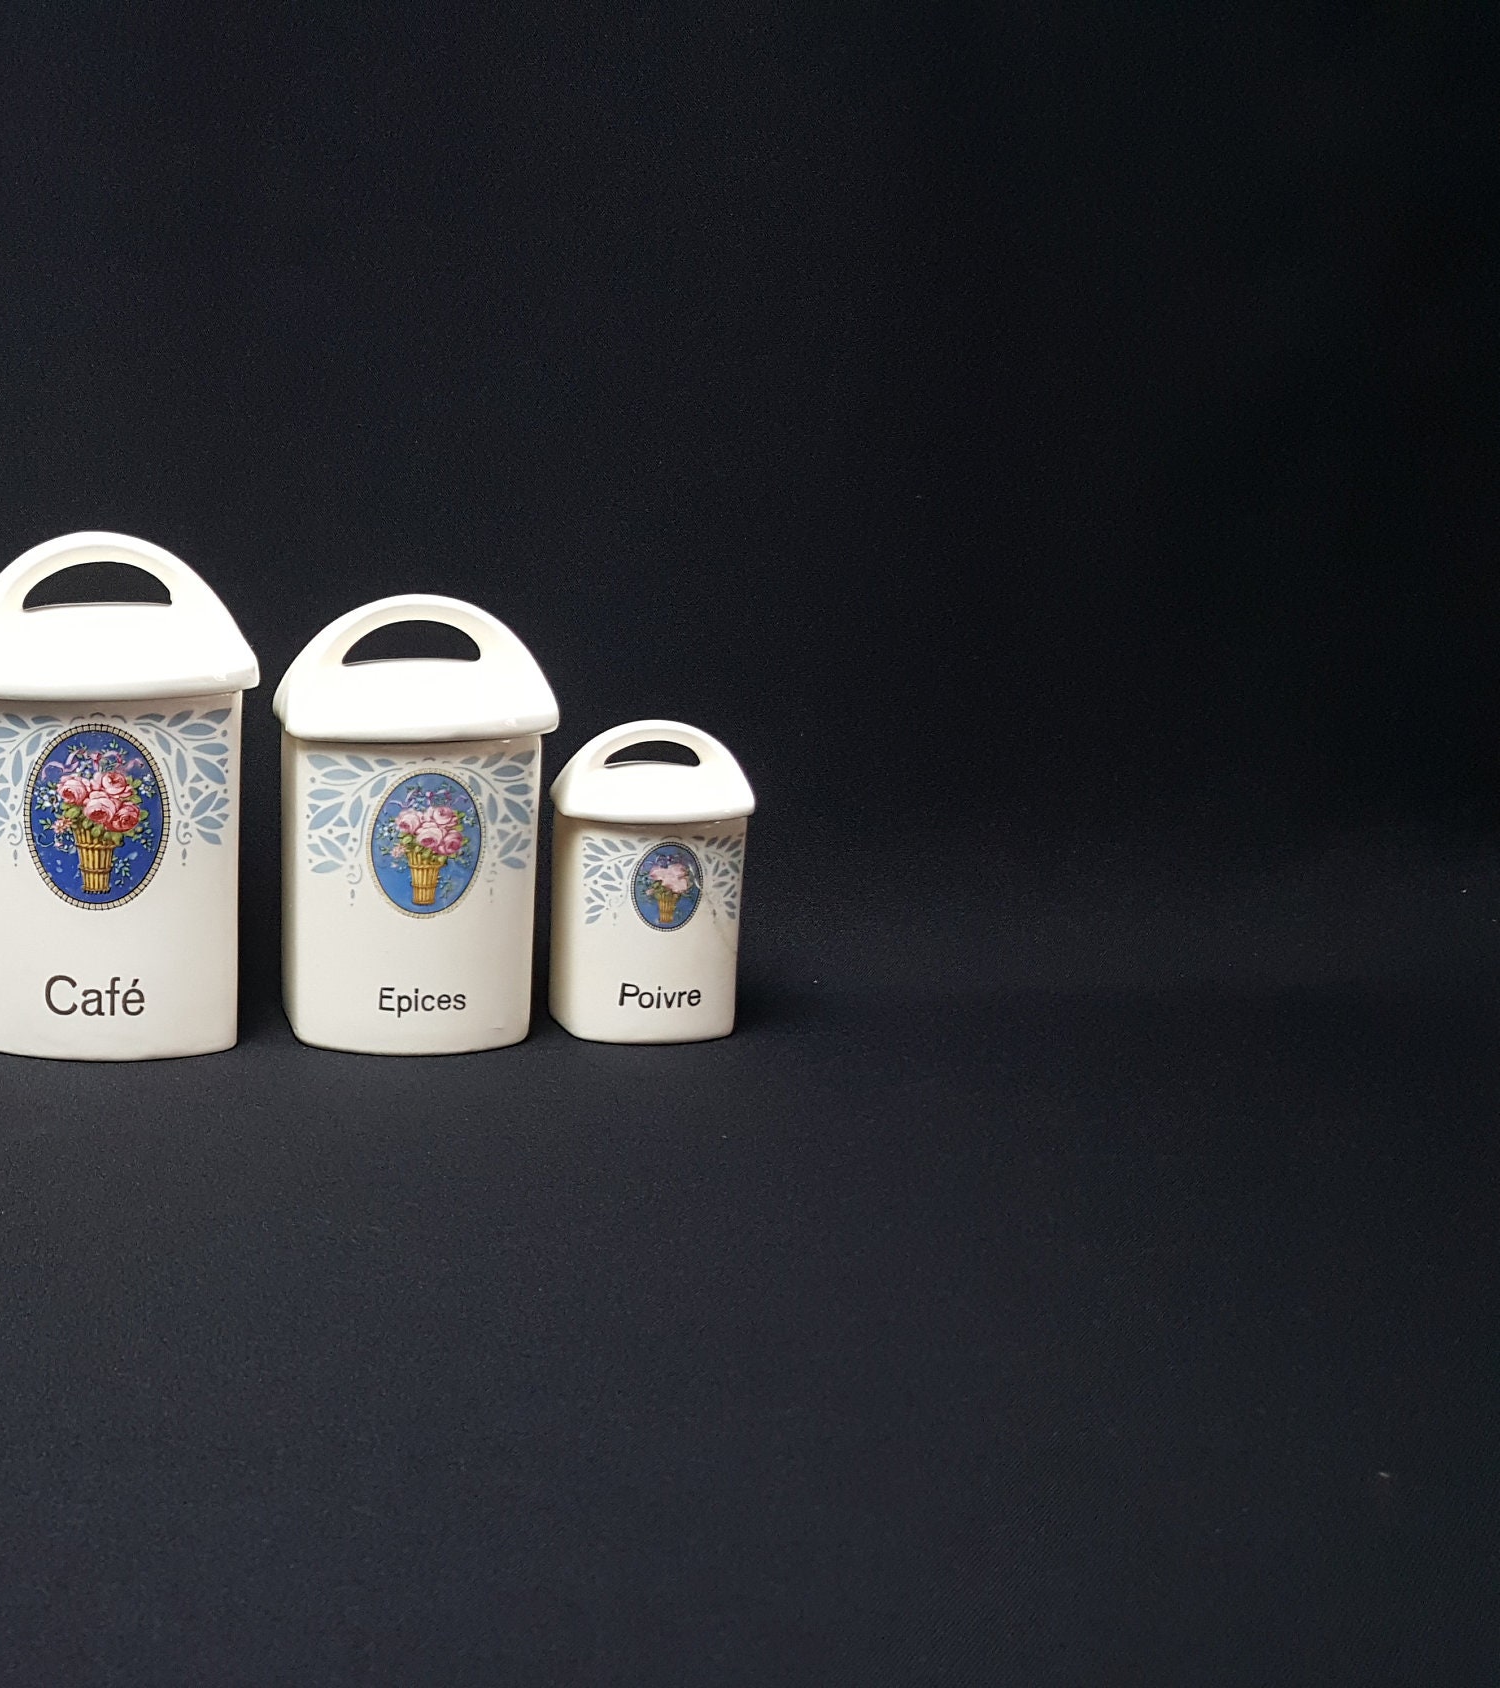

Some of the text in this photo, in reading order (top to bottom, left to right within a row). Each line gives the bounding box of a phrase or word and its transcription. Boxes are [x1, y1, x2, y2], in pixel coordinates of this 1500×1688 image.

[45, 975, 145, 1017] Café
[378, 987, 466, 1018] Epices
[618, 982, 702, 1009] Poivre
